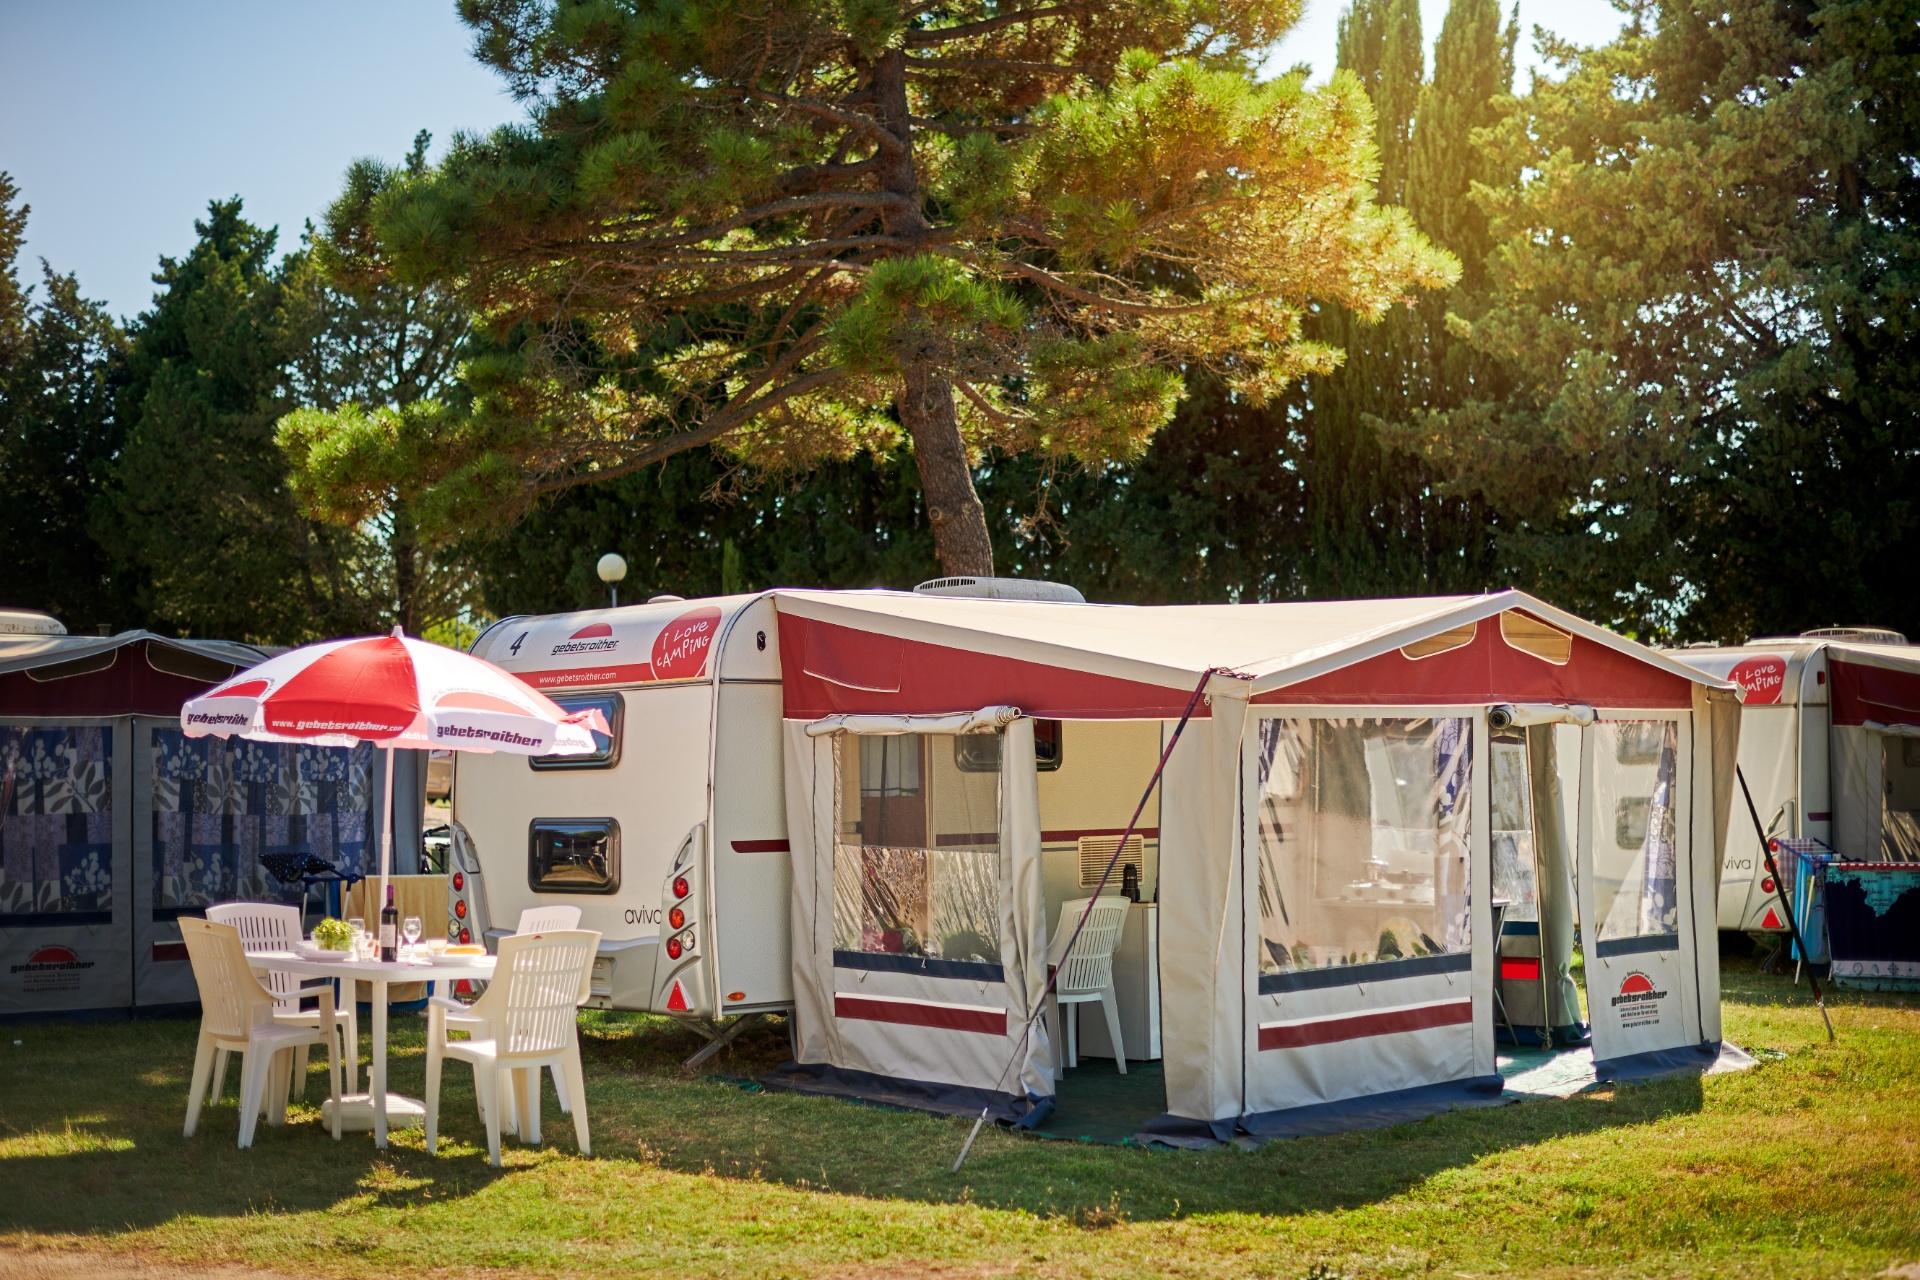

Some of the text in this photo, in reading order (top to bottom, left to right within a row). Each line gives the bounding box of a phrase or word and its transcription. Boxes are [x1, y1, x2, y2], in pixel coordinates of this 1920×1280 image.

[509, 630, 529, 656] 4
[550, 639, 619, 656] gebetsroither
[539, 671, 617, 685] www.gebetsroither.com
[436, 724, 543, 747] gebetsroither
[1724, 855, 1751, 870] viva
[10, 961, 95, 974] gebetsroither
[1611, 990, 1668, 1007] gebetsroither
